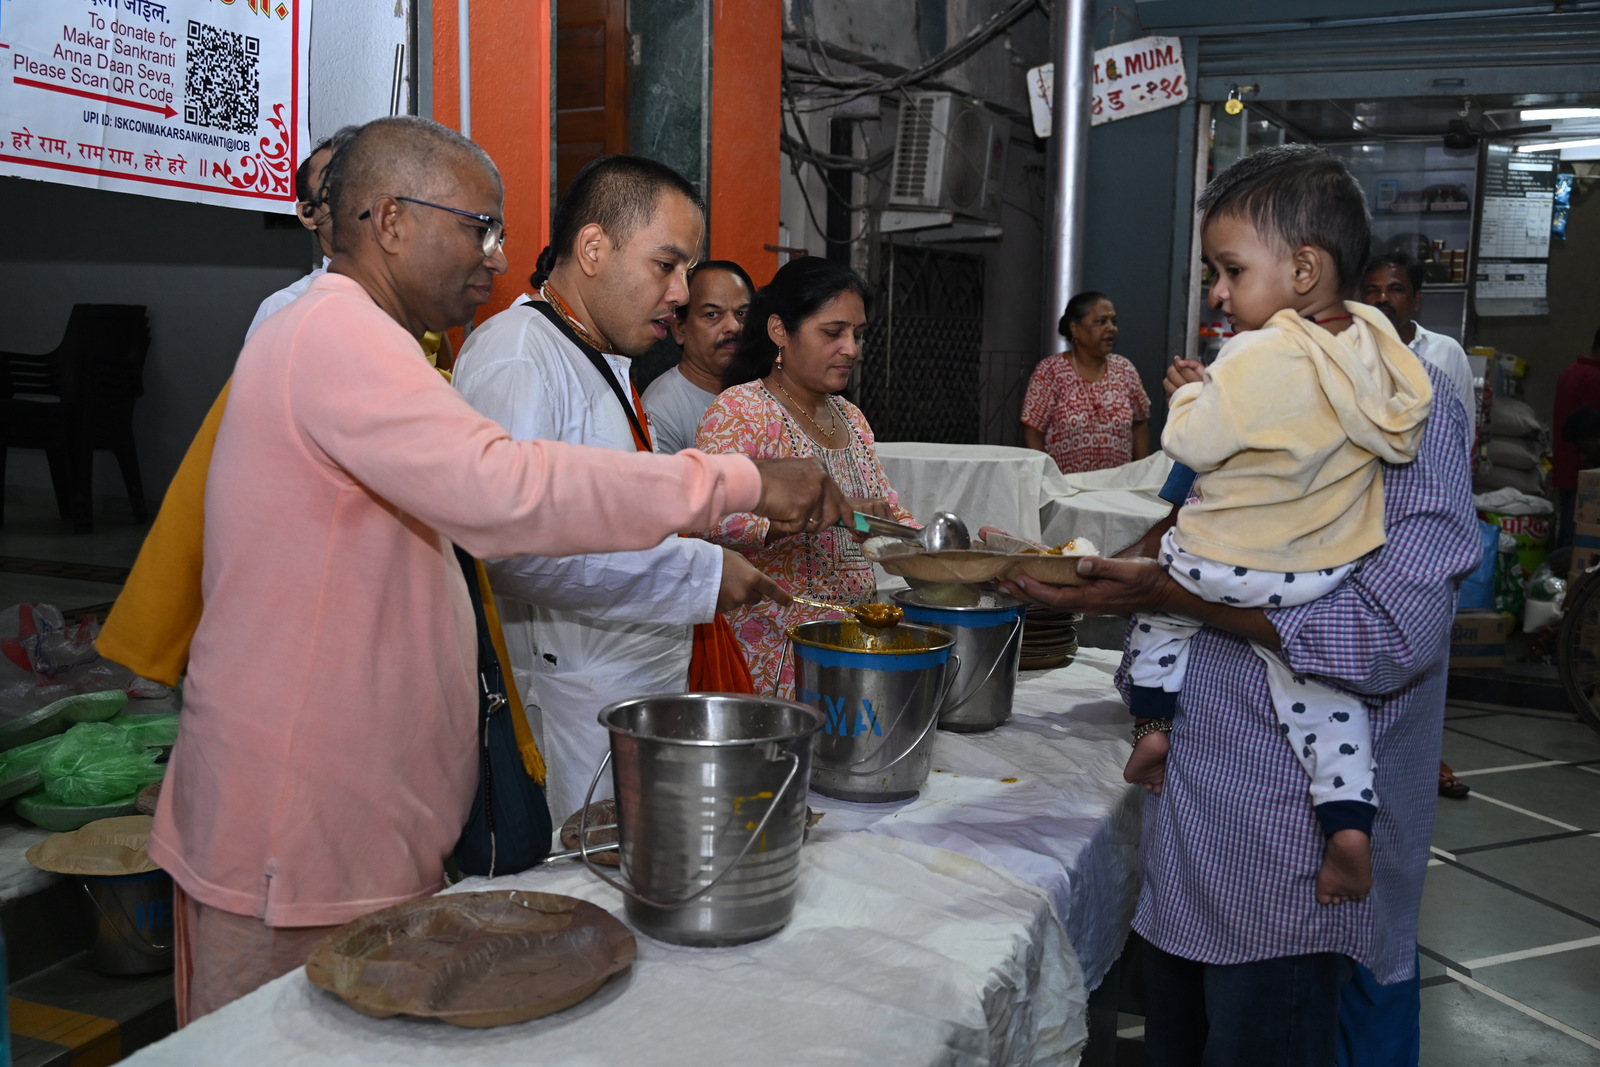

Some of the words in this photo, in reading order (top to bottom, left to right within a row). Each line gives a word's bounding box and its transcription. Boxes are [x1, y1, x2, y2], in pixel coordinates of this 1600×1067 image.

[63, 25, 111, 51] Makar
[113, 38, 176, 68] Sankranti
[88, 11, 106, 31] To
[110, 18, 156, 44] donate
[159, 31, 177, 50] for
[13, 53, 66, 80] Please
[70, 66, 109, 90] Scan
[112, 76, 135, 96] QR
[139, 82, 173, 104] Code
[53, 43, 92, 67] Anna
[97, 53, 133, 77] Daan
[137, 63, 175, 88] Seva,
[1124, 44, 1180, 76] MUM.
[10, 126, 34, 151] हरे
[37, 135, 71, 159] राम,
[77, 142, 105, 161] राम
[108, 147, 138, 170] राम,
[144, 149, 164, 171] हरे
[167, 153, 188, 176] हरे
[83, 110, 99, 125] UPI
[101, 114, 113, 127] ID:
[114, 116, 251, 152] ISKCONMAKARSANKRANTI@IOB
